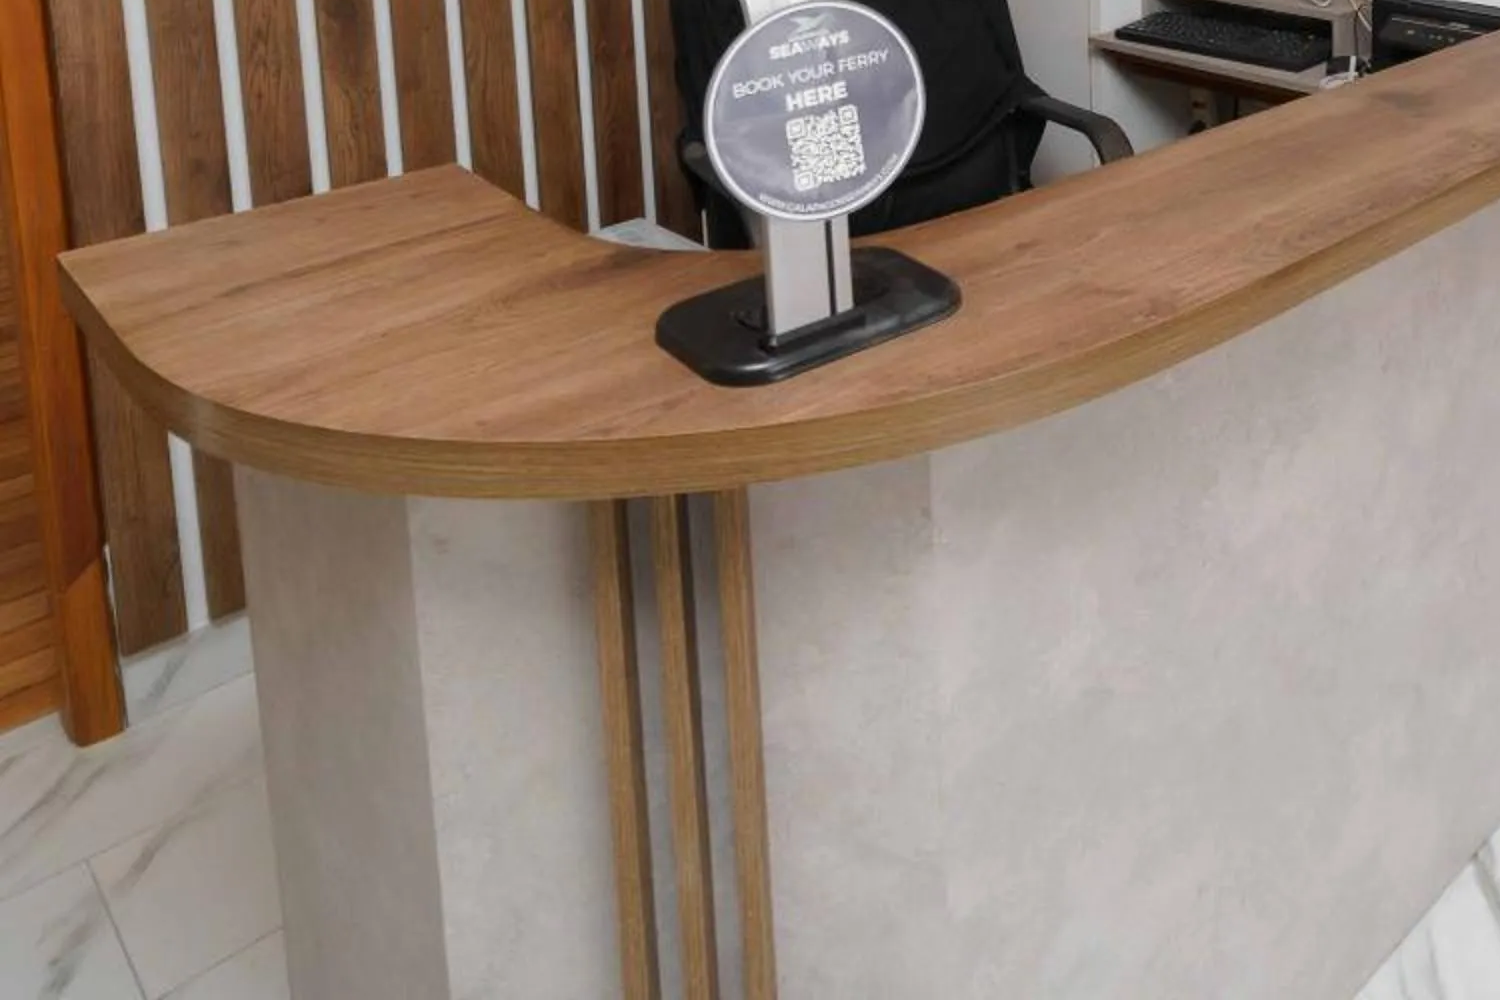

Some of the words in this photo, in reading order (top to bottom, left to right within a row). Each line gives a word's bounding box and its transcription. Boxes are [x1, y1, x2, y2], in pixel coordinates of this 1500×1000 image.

[768, 30, 850, 60] SEAWAYS
[732, 74, 786, 99] BOOK
[787, 61, 836, 86] YOUR
[838, 48, 890, 73] FERRY
[785, 81, 849, 112] HERE
